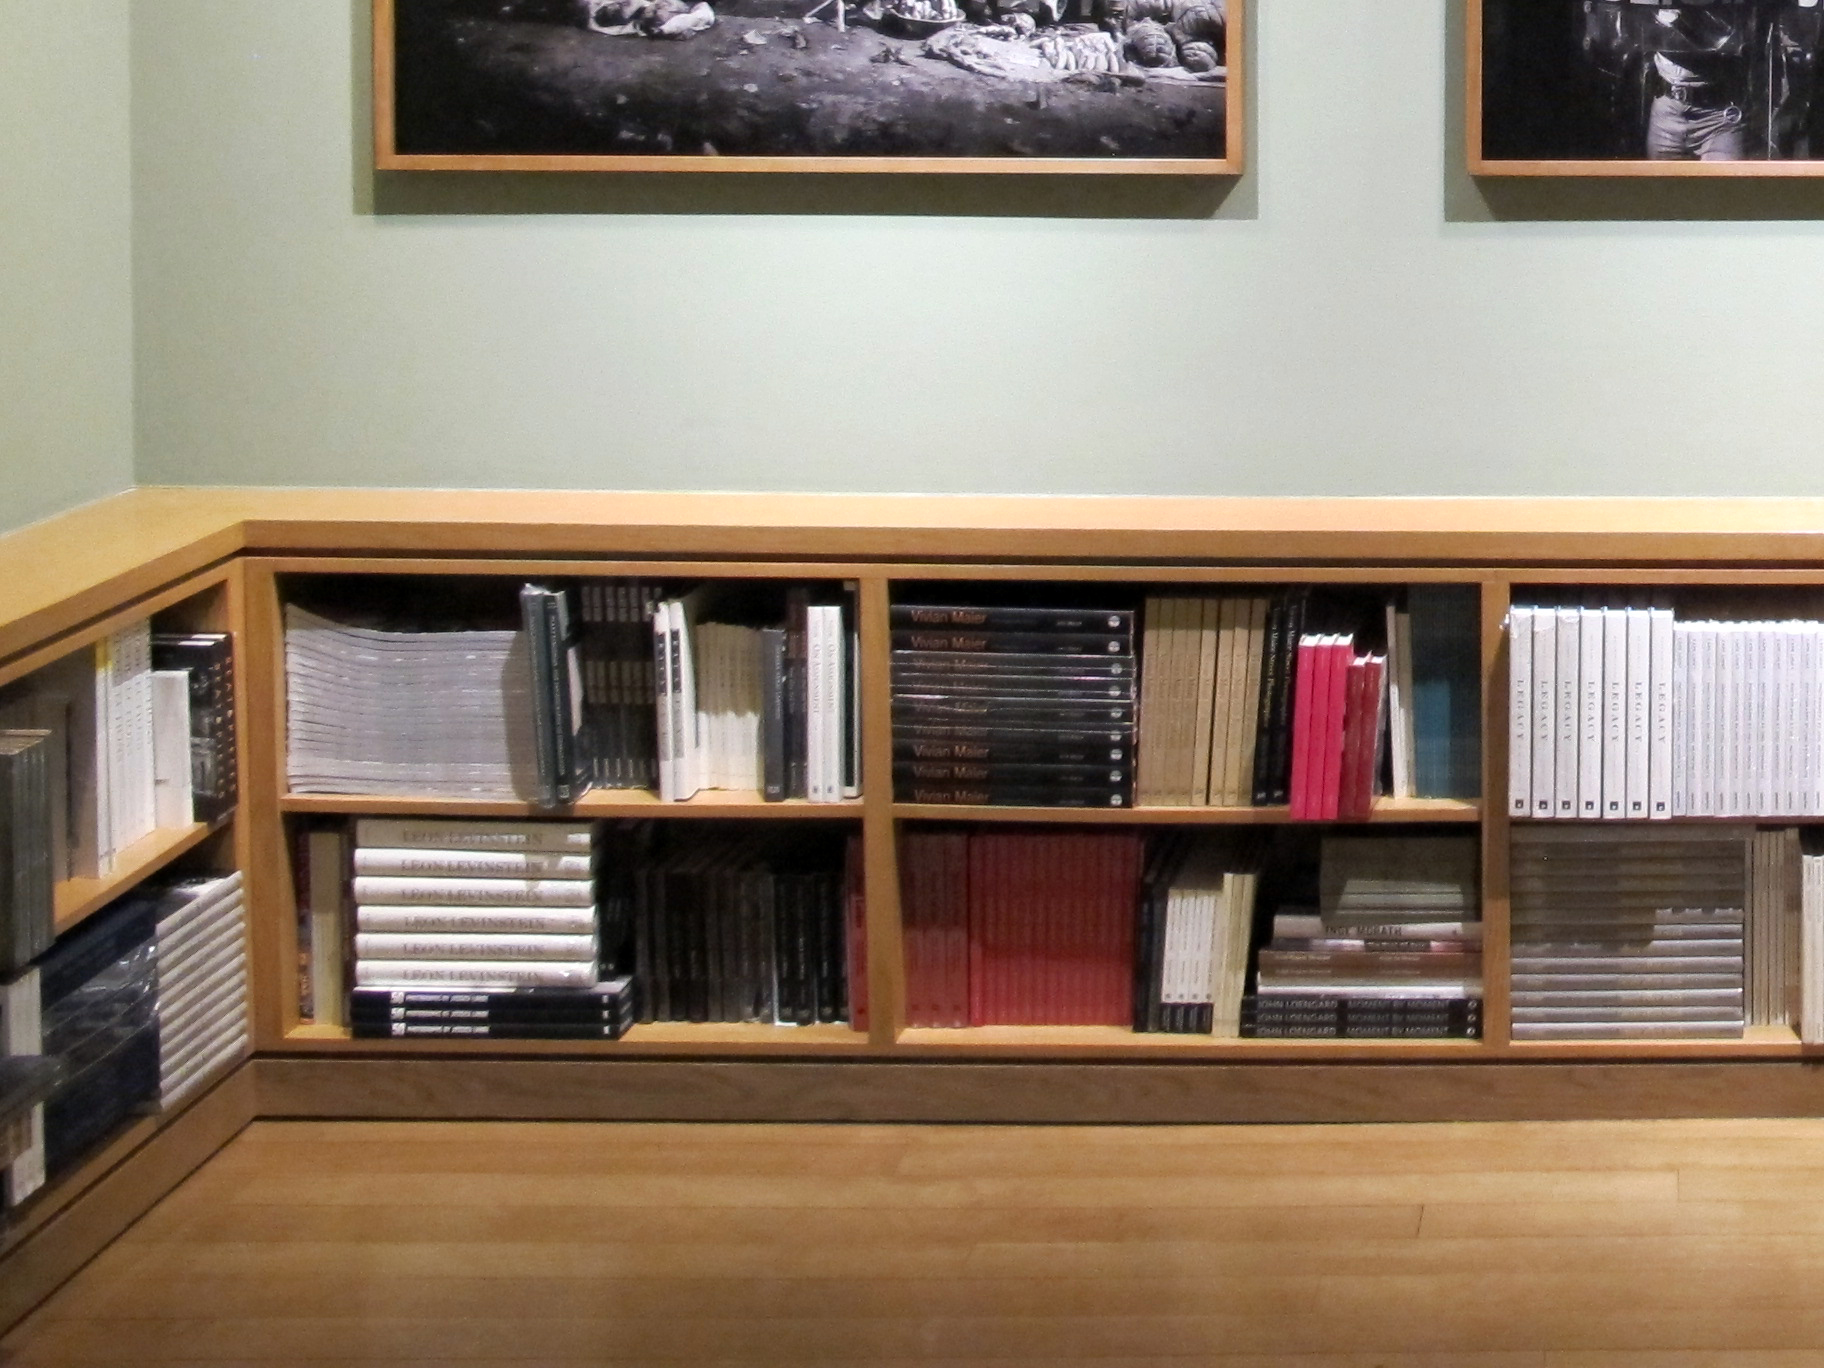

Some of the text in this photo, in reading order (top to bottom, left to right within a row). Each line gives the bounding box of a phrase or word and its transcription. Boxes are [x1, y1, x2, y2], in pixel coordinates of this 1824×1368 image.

[911, 610, 987, 625] Vivian Maier
[911, 635, 987, 650] Vivian Maier
[1516, 679, 1525, 739] LEGACY
[1540, 680, 1549, 741] LEGACY
[1563, 680, 1572, 741] LEGACY
[1587, 681, 1596, 742] LEGACY
[1611, 682, 1620, 742] LEGACY
[1634, 682, 1643, 742] LEGACY
[1657, 682, 1667, 743] LEGACY
[912, 744, 989, 758] Vivian Maier
[912, 766, 989, 779] Vivian Maier
